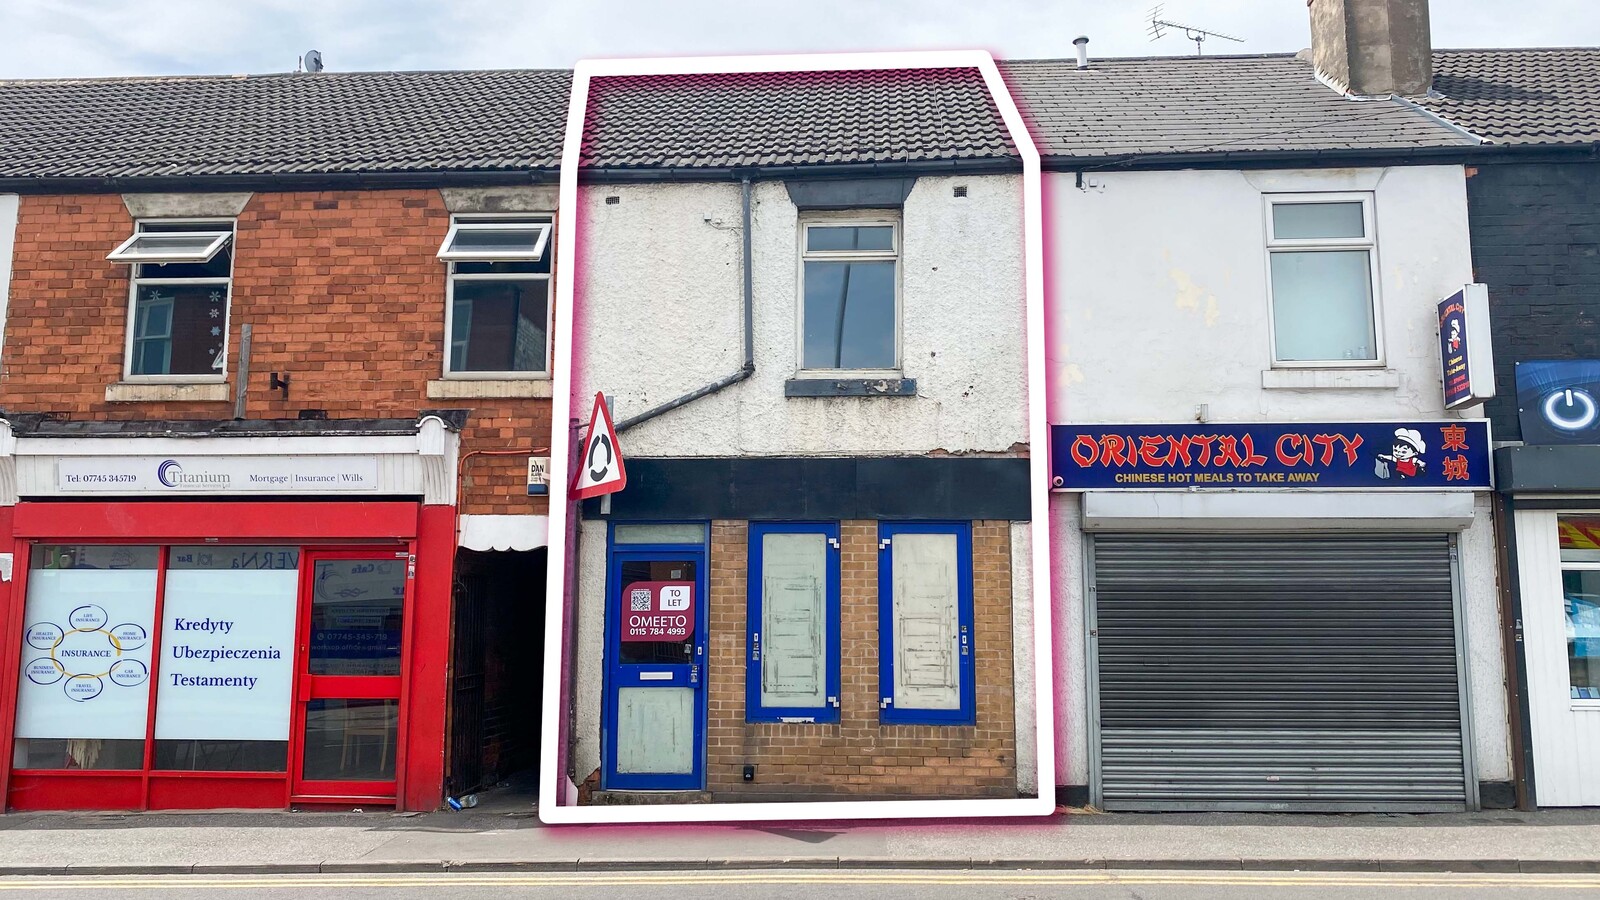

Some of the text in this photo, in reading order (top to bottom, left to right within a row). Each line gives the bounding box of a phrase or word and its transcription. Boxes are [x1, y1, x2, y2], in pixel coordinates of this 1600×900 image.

[1071, 433, 1364, 468] ORIENTAL CITY
[1440, 423, 1470, 481] 東城
[65, 474, 137, 483] Tel: 07745 345719
[169, 471, 231, 483] Titanium
[249, 474, 363, 484] Mortgage Insurance Wills
[1115, 473, 1320, 483] CHINESE HOT MEALS TO TAKE AWAY
[670, 589, 681, 597] TO
[667, 599, 682, 607] LET
[174, 618, 234, 634] Kredyty
[629, 615, 687, 627] OMEETO
[629, 627, 686, 636] 0115 784 4993
[173, 645, 281, 662] Ubezpieczenia
[170, 673, 258, 690] Testamenty
